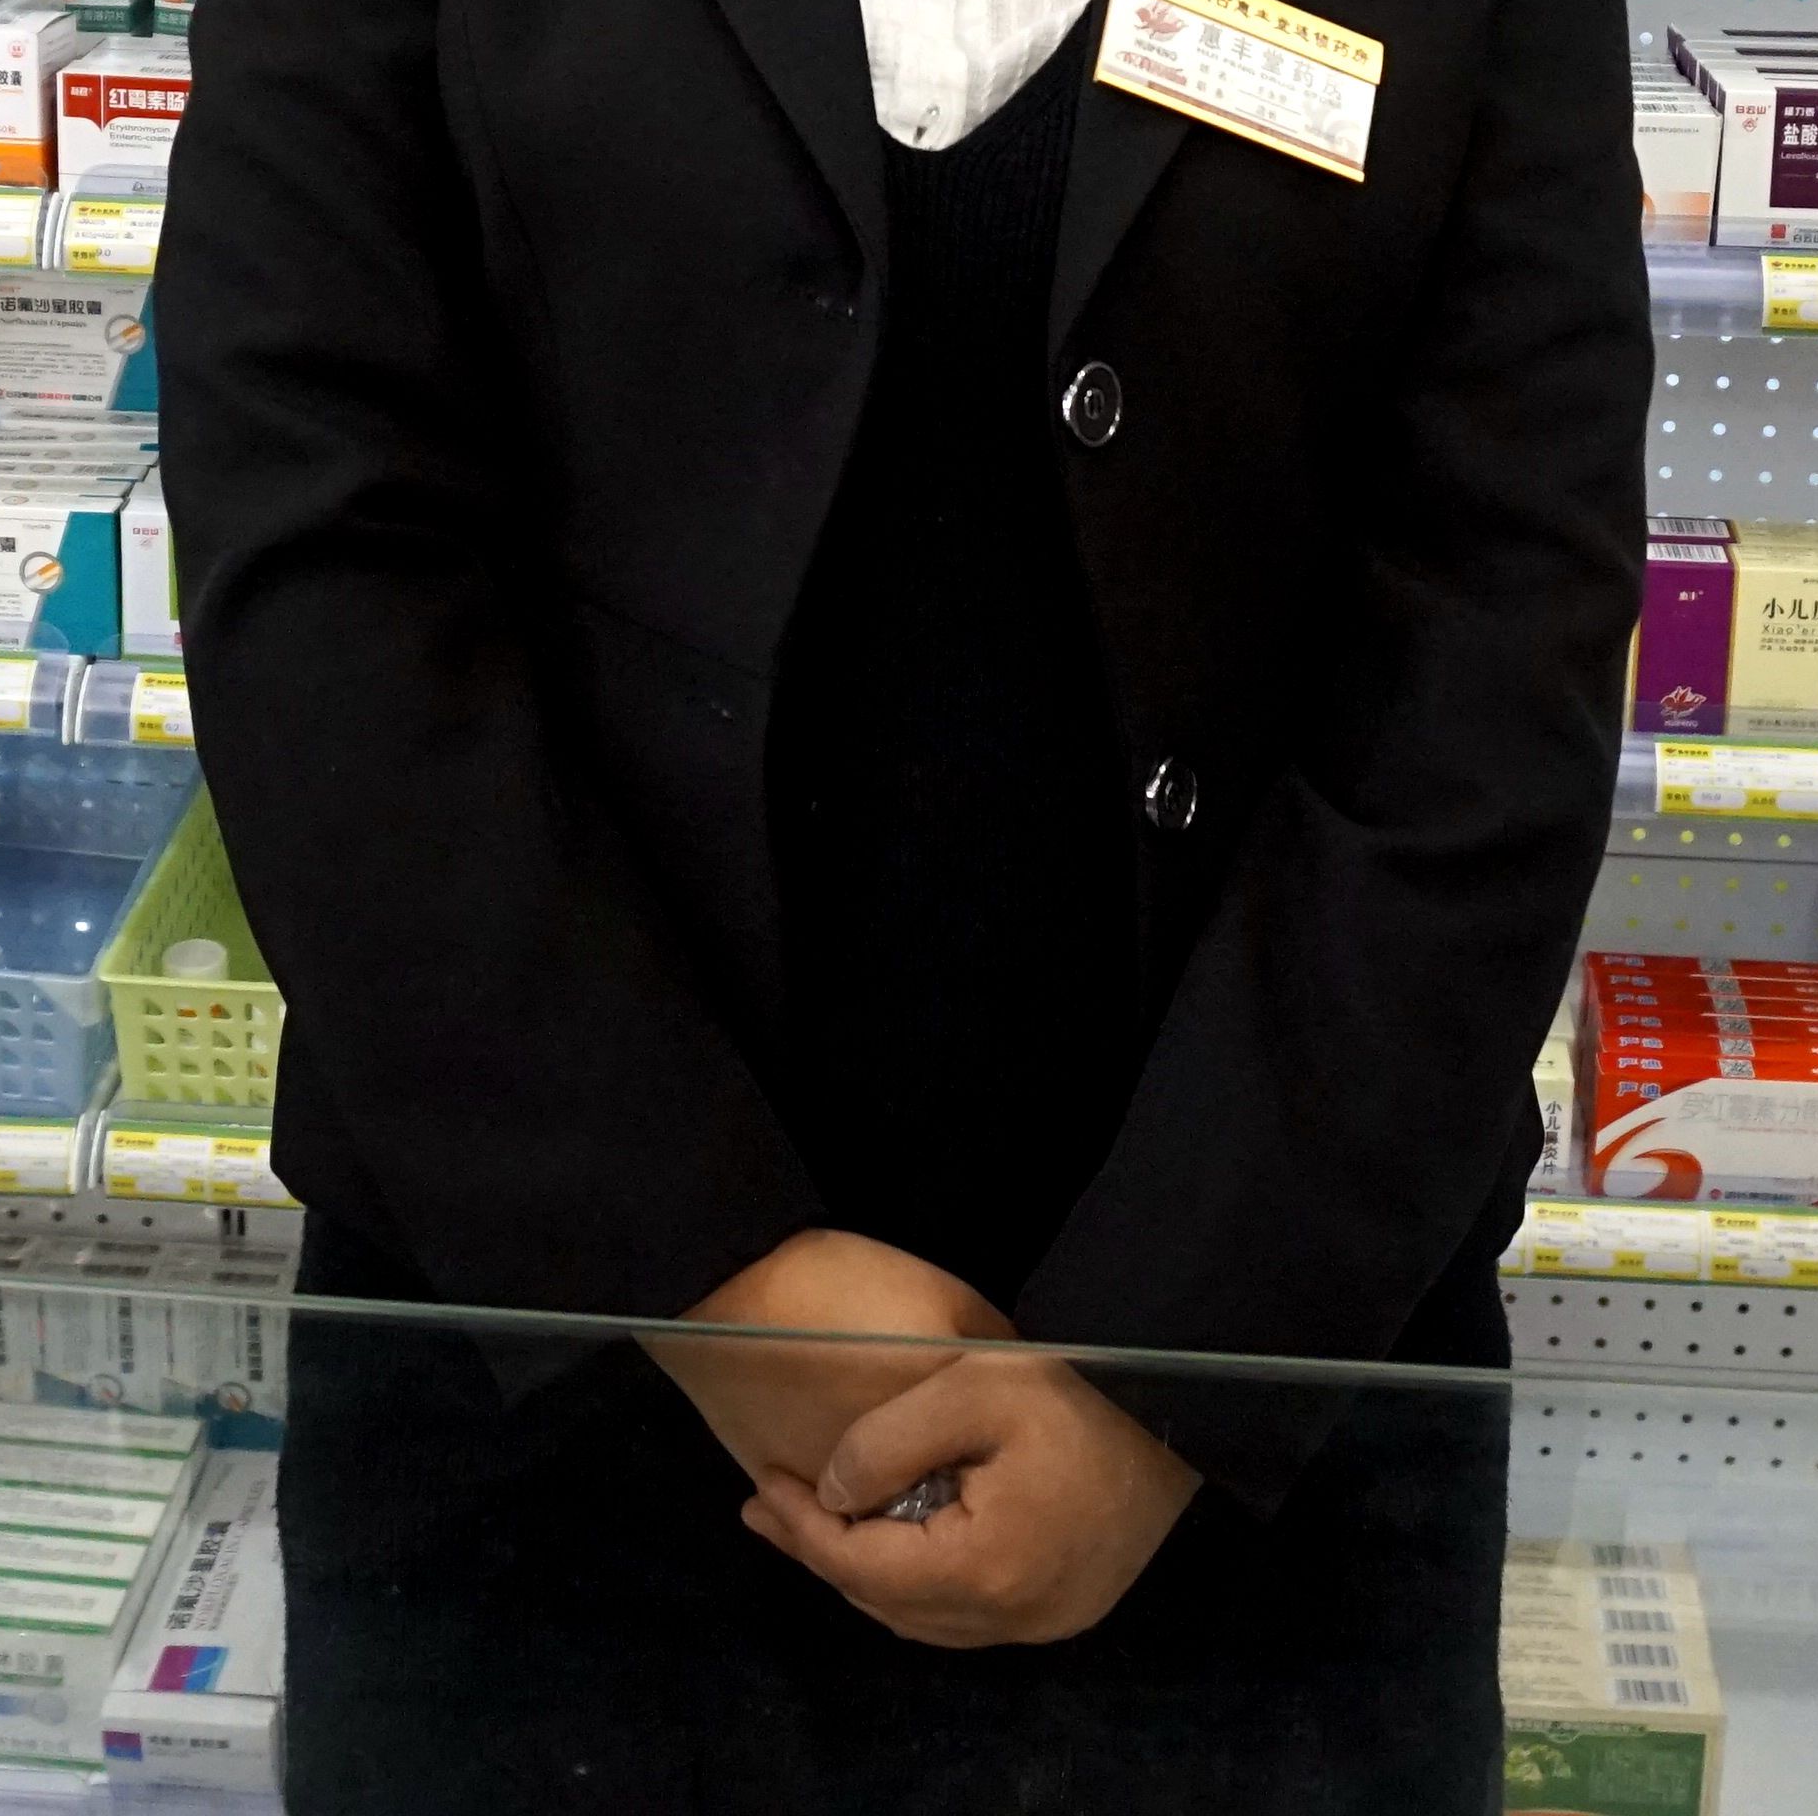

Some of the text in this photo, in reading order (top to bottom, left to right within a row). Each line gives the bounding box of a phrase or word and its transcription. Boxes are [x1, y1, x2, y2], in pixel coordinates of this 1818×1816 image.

[109, 87, 190, 110] 红霉素肠
[0, 295, 103, 316] 诺氟沙星胶囊
